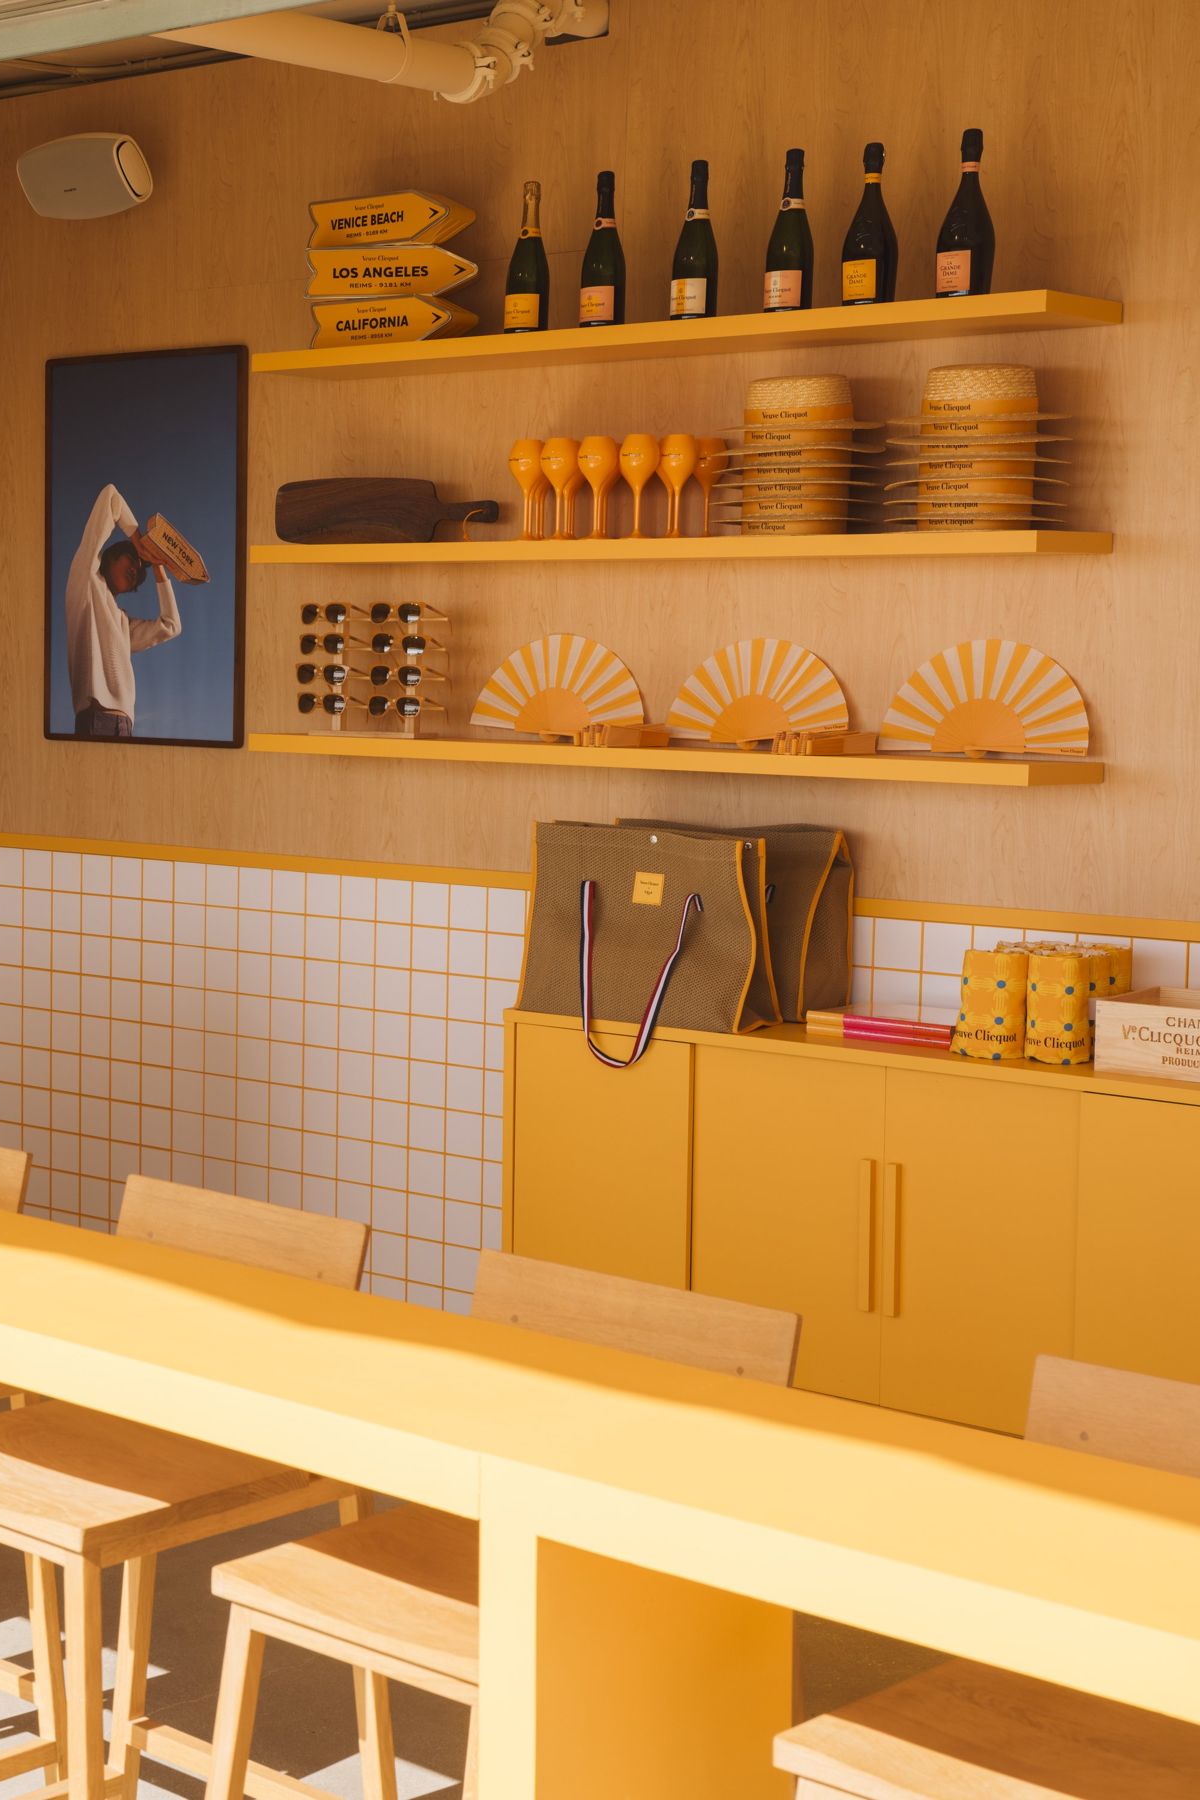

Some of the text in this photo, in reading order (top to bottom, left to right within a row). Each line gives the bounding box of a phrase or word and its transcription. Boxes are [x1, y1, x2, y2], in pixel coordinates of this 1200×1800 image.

[331, 210, 404, 231] VENICE BEACH
[332, 266, 429, 279] LOS ANGELES
[336, 315, 409, 332] CALIFORNIA
[762, 411, 808, 420] Veuve Clicquot
[765, 432, 791, 441] Clicquot
[775, 502, 803, 511] Clicquot
[162, 531, 179, 549] NEW
[178, 547, 194, 567] YORK
[1165, 1016, 1200, 1029] CHA
[956, 1029, 1017, 1045] euve Clicquot
[1044, 1037, 1086, 1051] Clicquot
